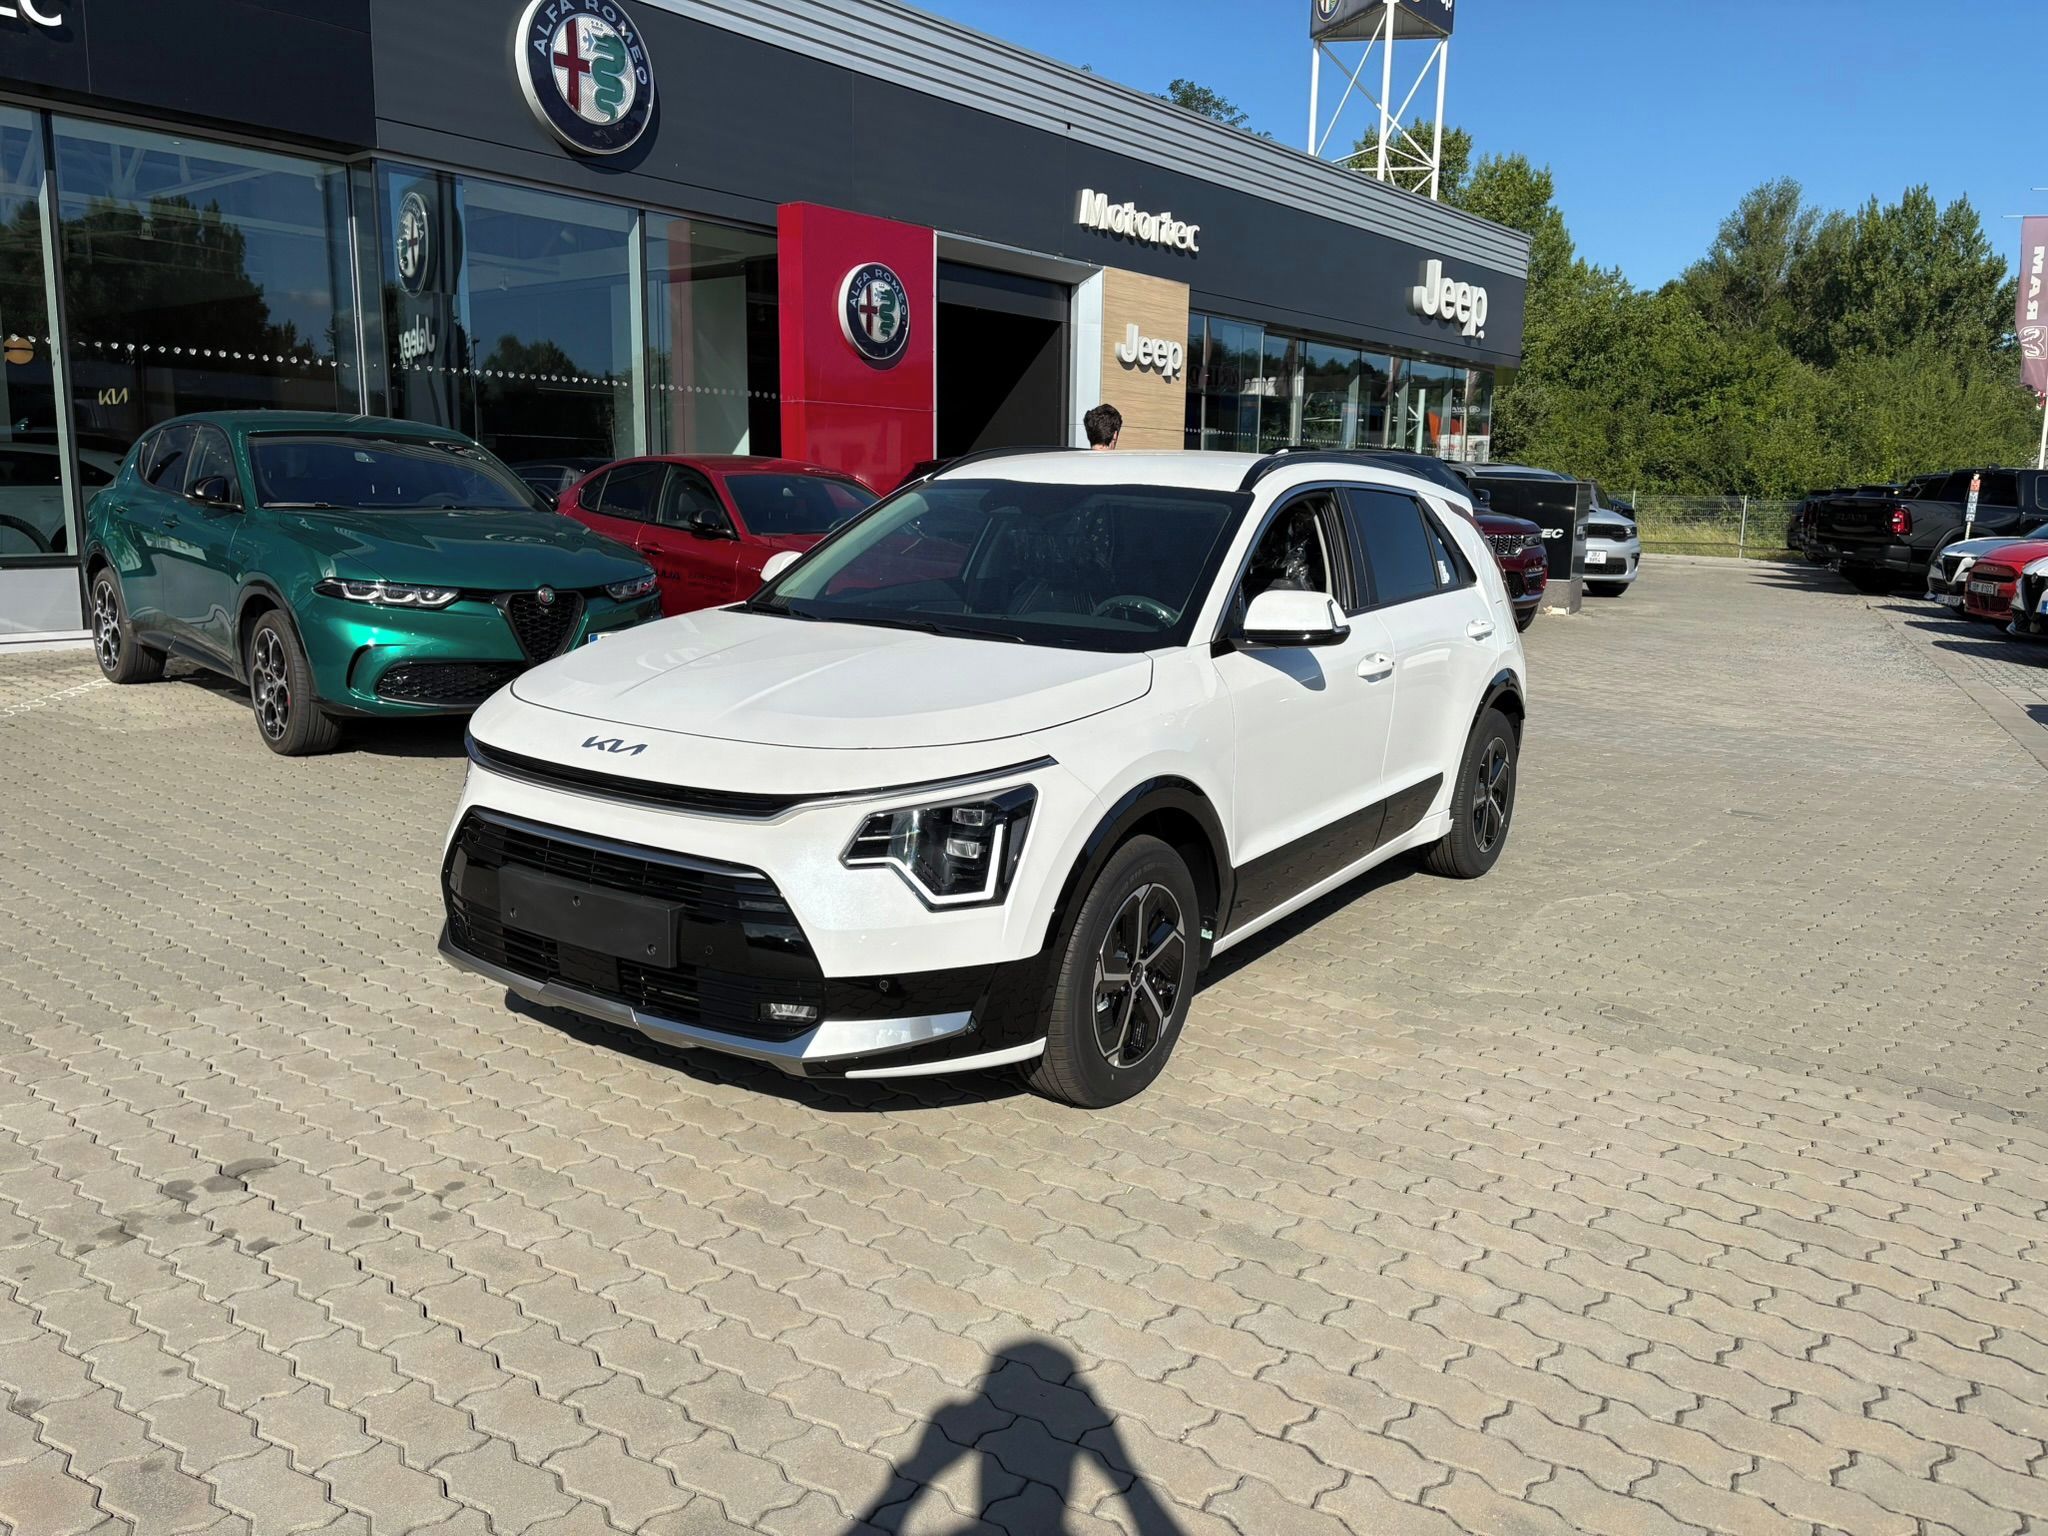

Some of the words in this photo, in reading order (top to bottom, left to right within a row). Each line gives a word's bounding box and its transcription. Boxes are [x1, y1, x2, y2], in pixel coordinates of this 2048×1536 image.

[534, 0, 575, 56] ALFA
[585, 0, 648, 85] ROMEO
[1079, 188, 1200, 252] Motortec
[849, 272, 871, 308] ALFA
[875, 269, 907, 315] ROMEO
[1412, 259, 1488, 337] Jeep
[1115, 323, 1183, 377] Jeep
